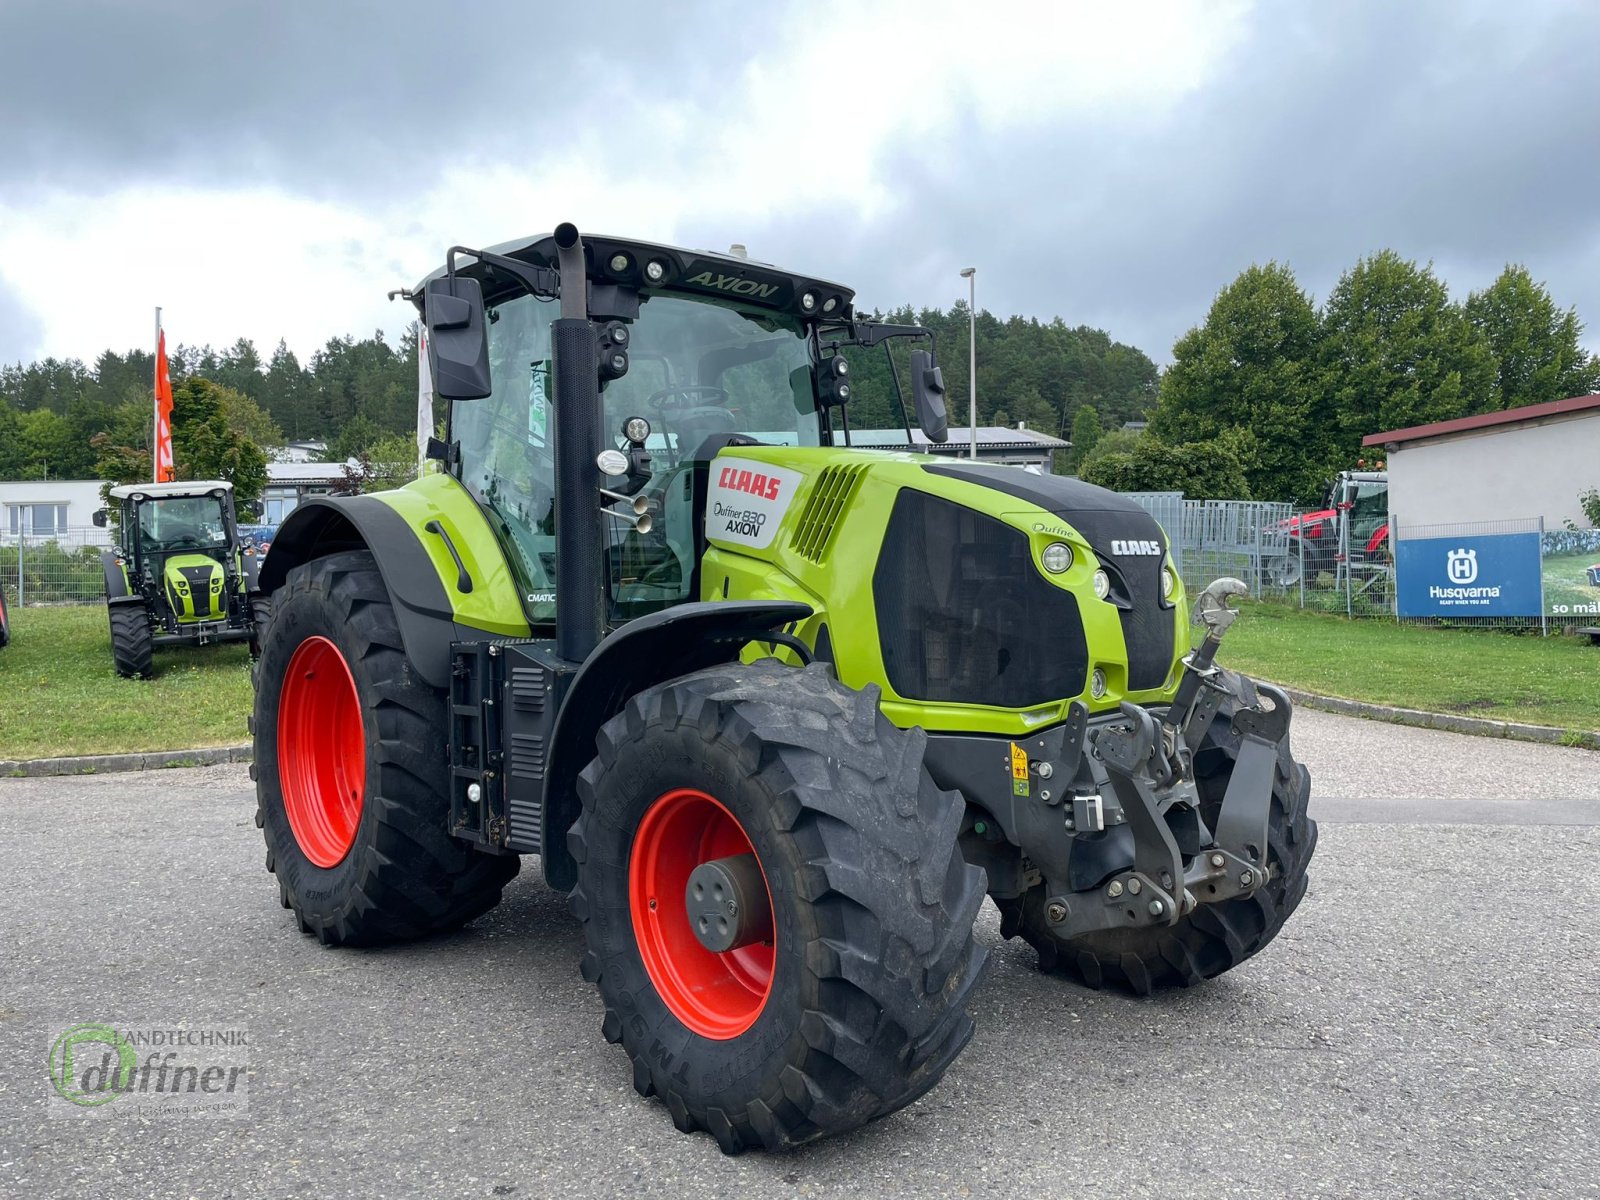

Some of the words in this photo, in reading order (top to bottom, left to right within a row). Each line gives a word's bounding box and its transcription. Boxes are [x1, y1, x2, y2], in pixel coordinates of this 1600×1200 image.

[686, 271, 780, 298] AXION
[718, 467, 781, 501] CLAAS
[713, 501, 742, 519] Duffner
[741, 510, 767, 526] 830
[725, 520, 760, 537] AXION
[1111, 540, 1161, 556] CLAAS
[527, 593, 557, 603] CMATIC
[1429, 585, 1501, 600] Husqvarna
[1552, 604, 1569, 614] so
